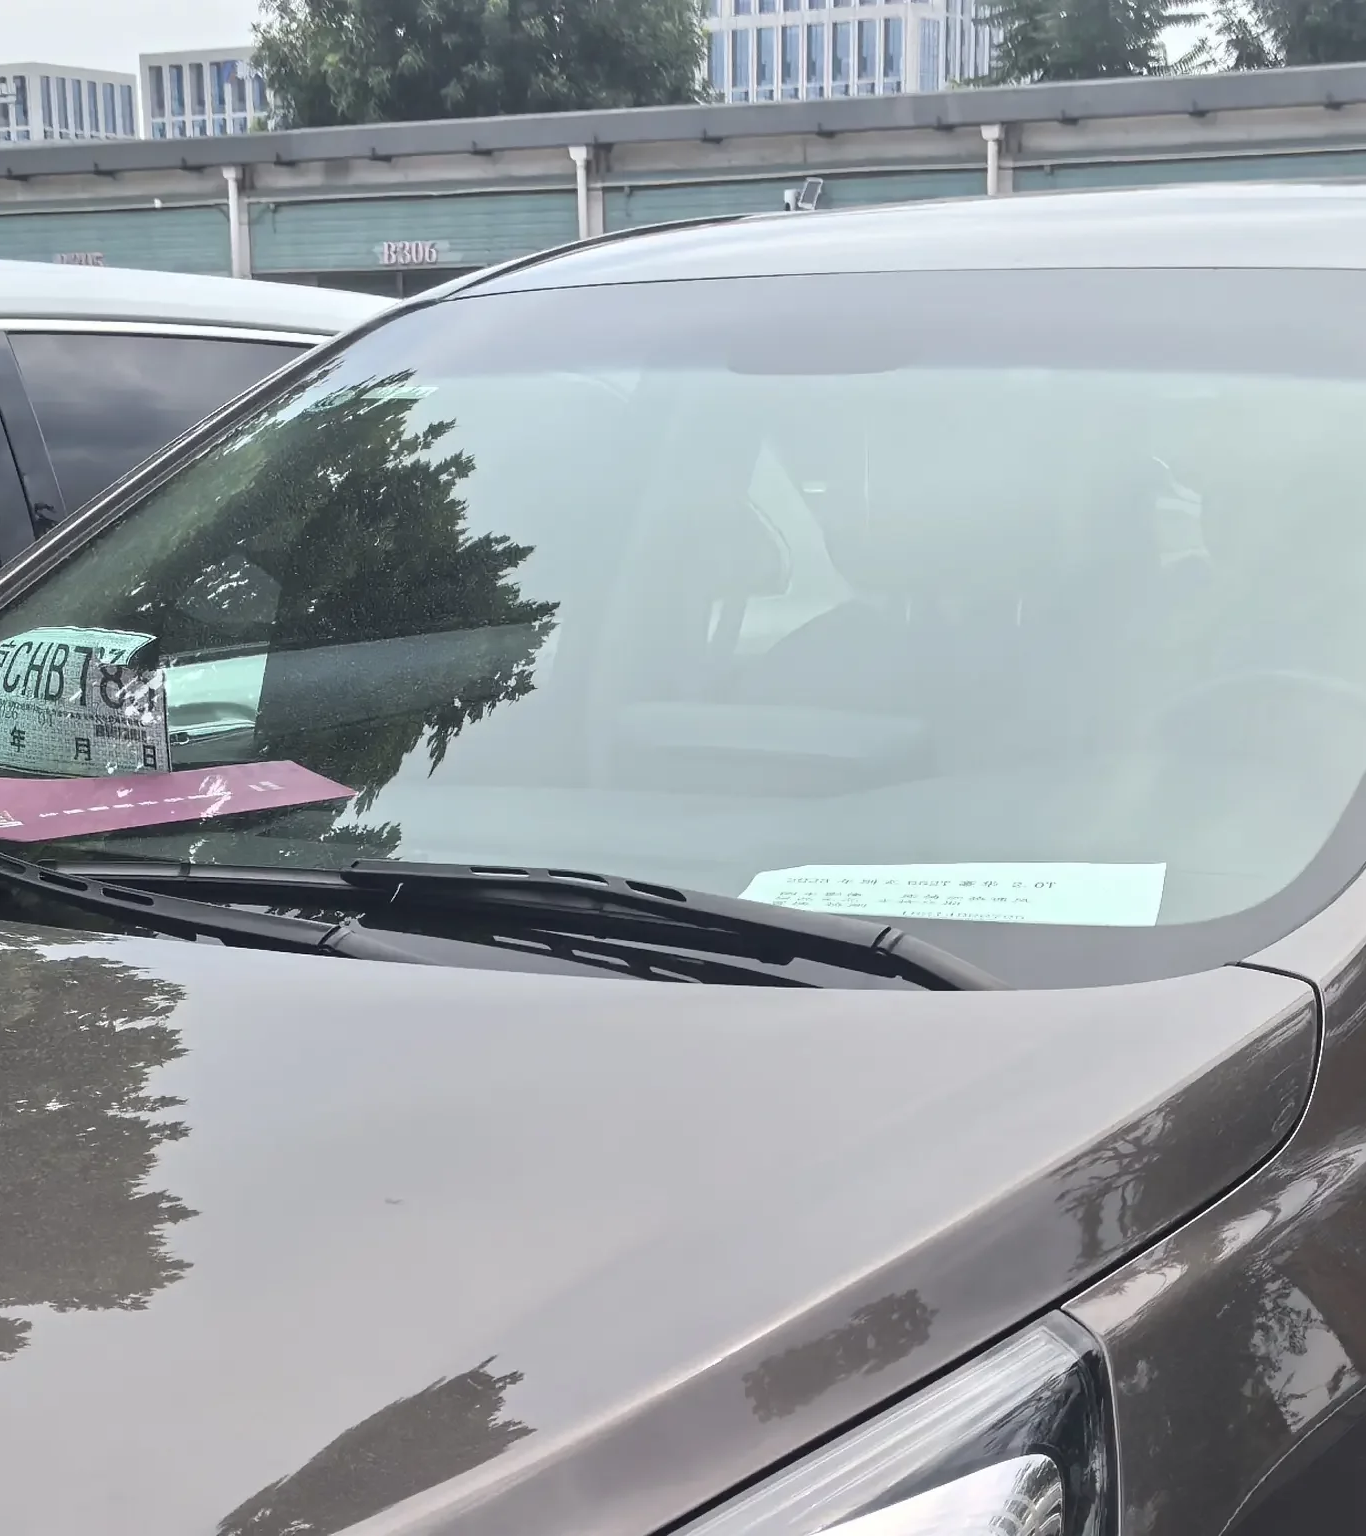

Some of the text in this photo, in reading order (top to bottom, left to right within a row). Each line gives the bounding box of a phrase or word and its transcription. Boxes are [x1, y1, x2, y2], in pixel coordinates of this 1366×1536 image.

[382, 241, 438, 264] B306
[73, 737, 93, 761] 月
[142, 744, 157, 770] 日
